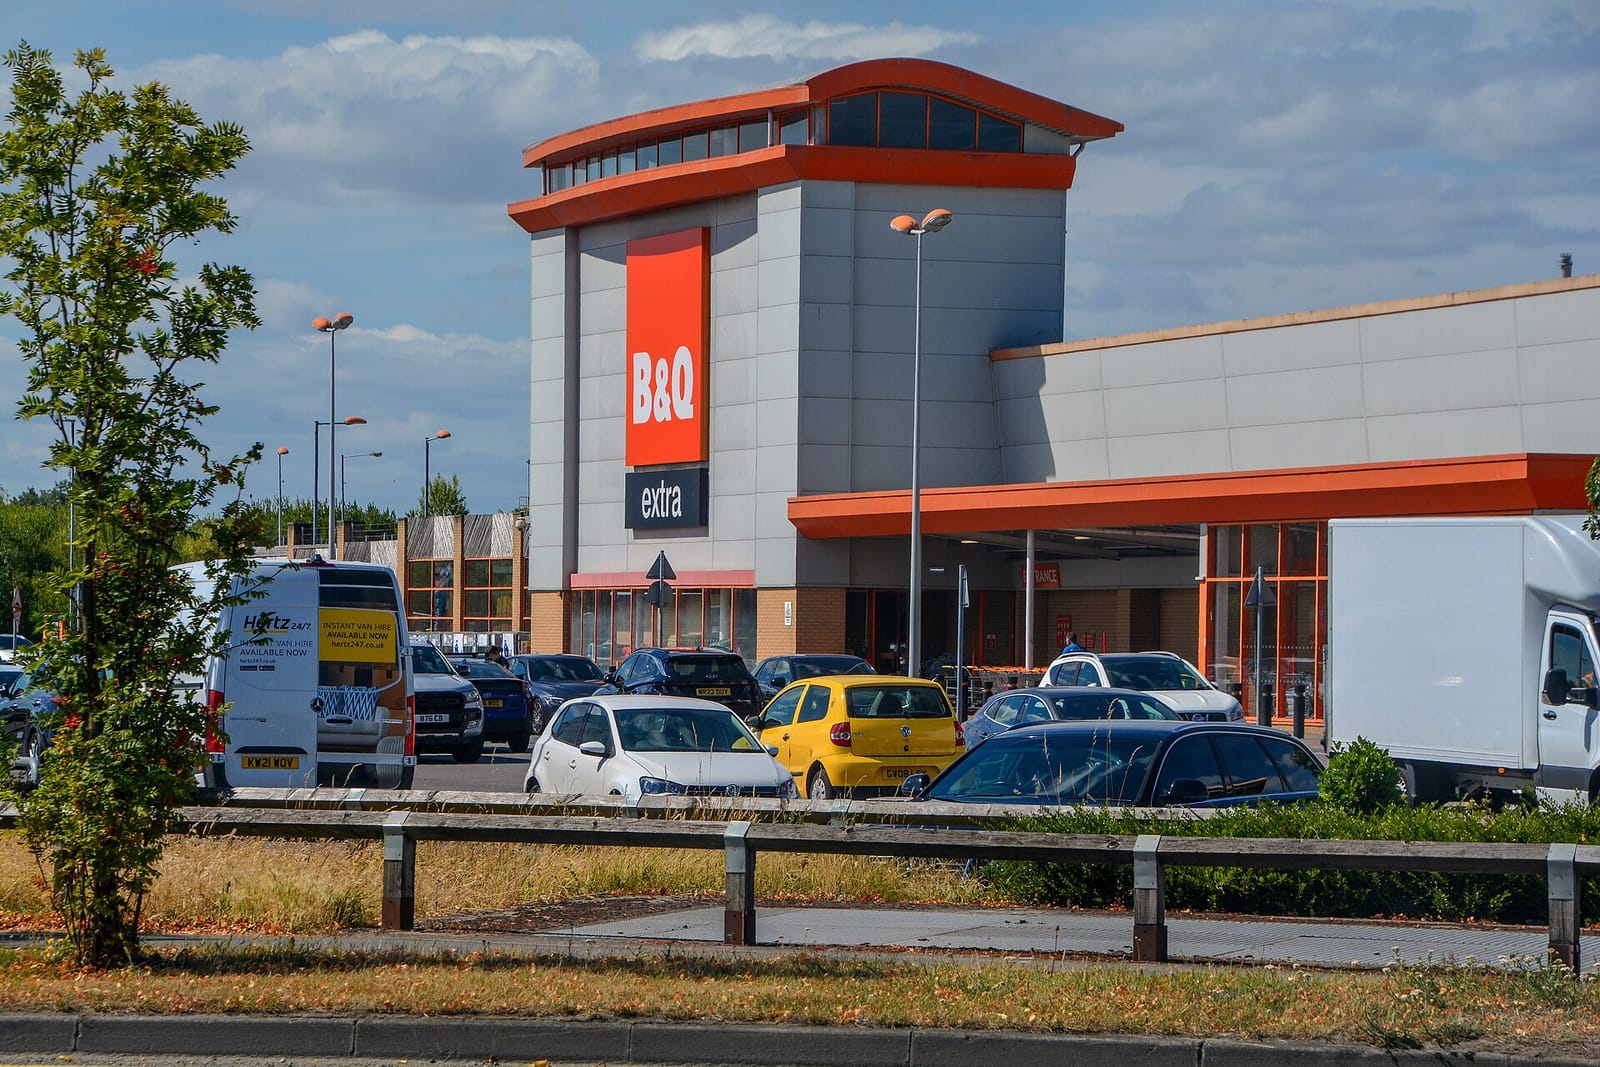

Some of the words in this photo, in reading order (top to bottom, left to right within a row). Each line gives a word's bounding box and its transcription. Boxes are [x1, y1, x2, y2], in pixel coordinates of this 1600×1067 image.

[632, 345, 694, 425] B&Q
[641, 479, 682, 519] extra
[291, 622, 312, 631] 24/7
[323, 622, 355, 630] INSTANT
[375, 623, 391, 631] HIRE
[327, 632, 368, 640] AVAILABLE
[369, 632, 389, 640] NOW
[276, 640, 293, 648] VAN
[294, 640, 313, 648] HIRE
[331, 641, 384, 649] hertz247.co.uk
[886, 769, 908, 778] GV08
